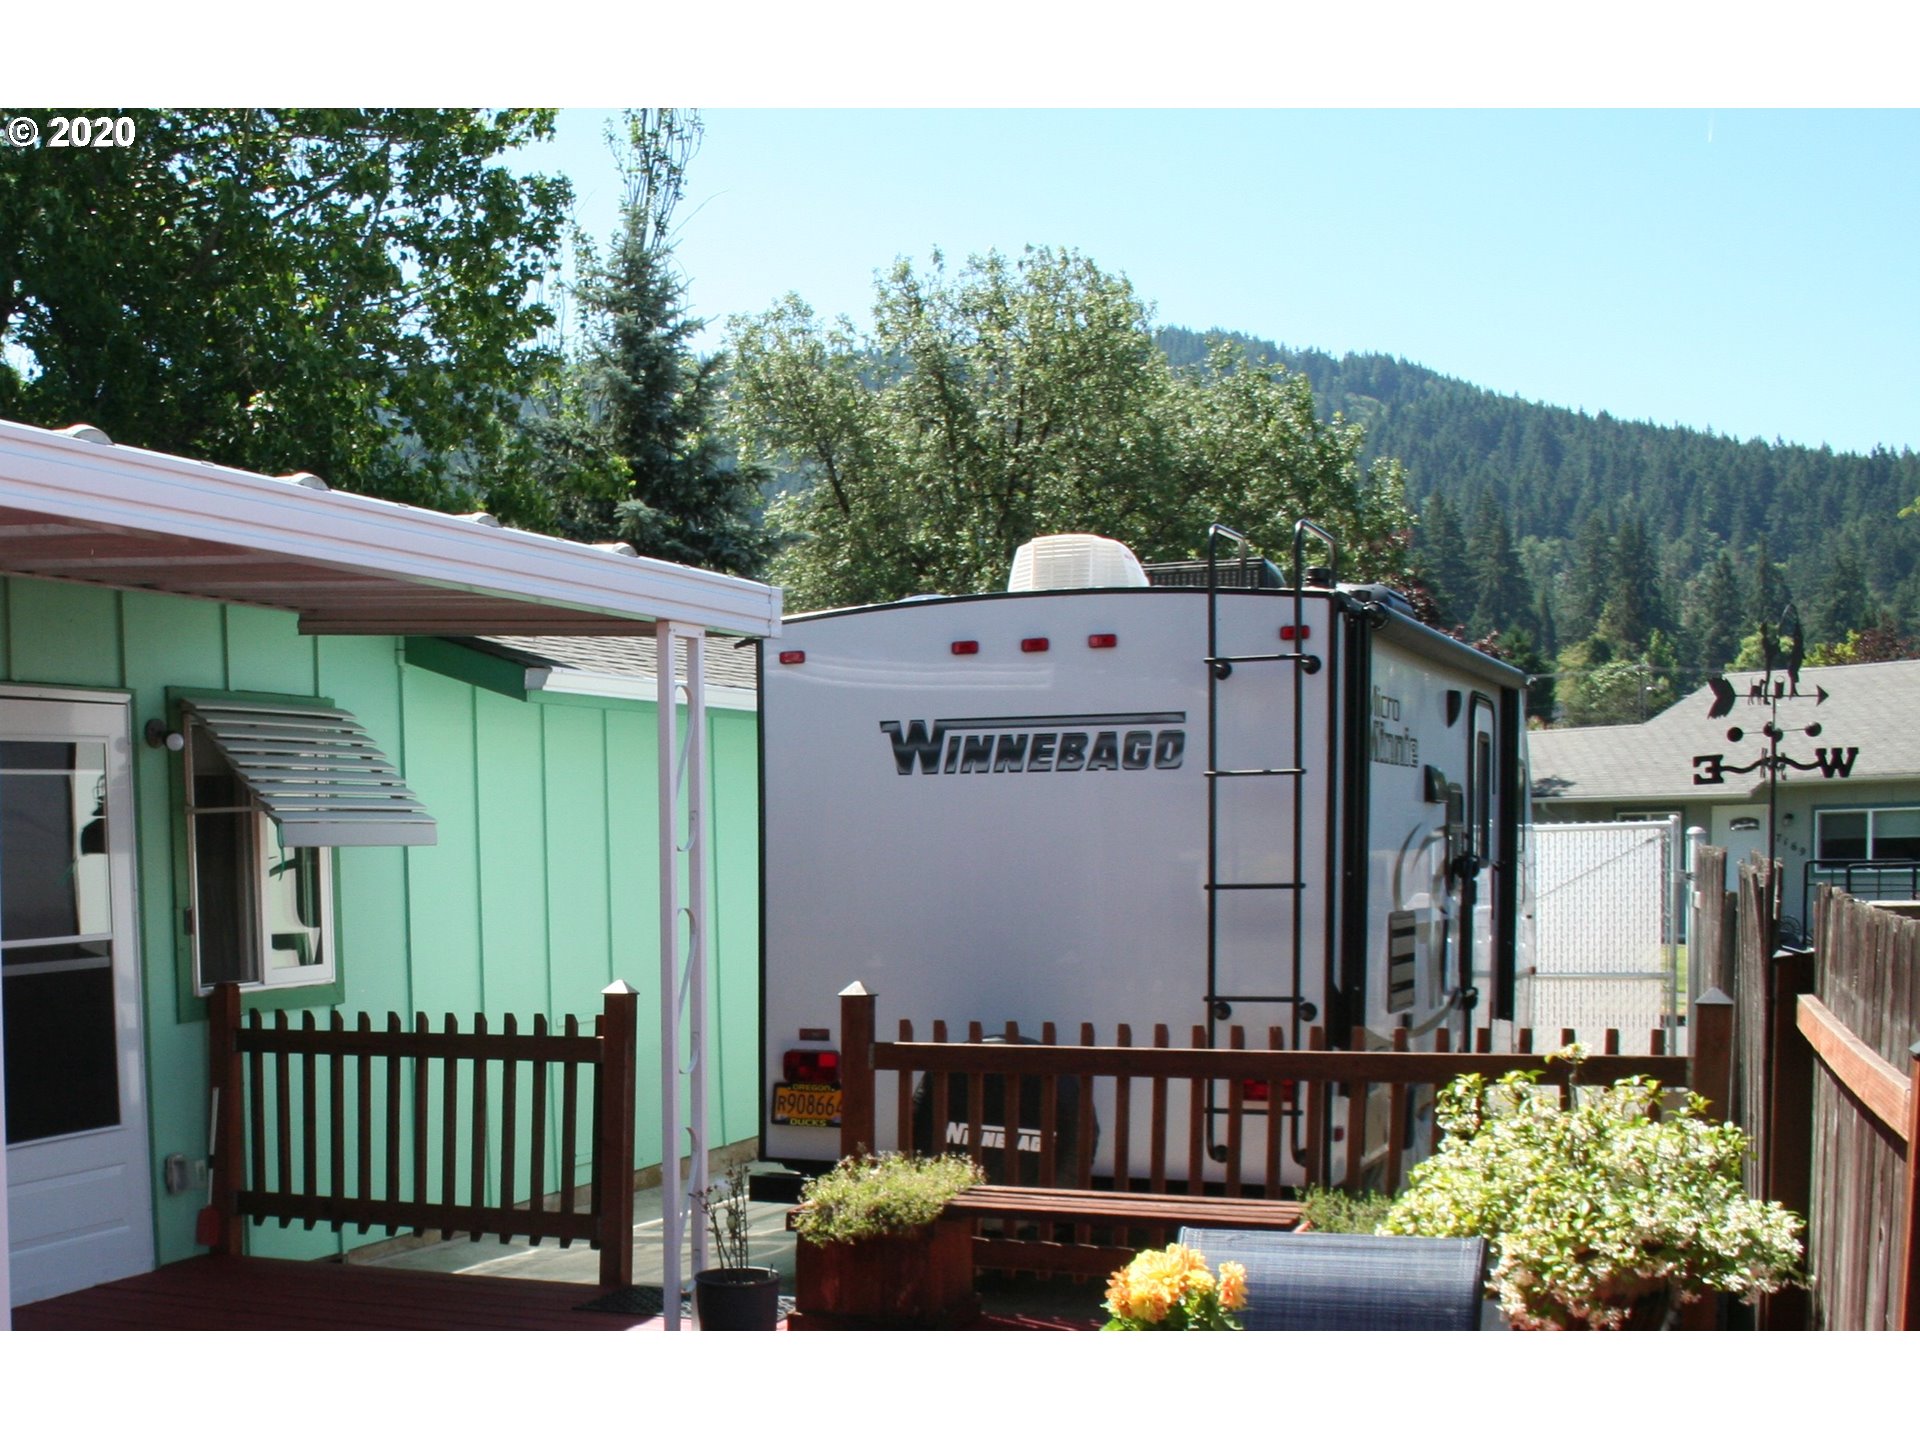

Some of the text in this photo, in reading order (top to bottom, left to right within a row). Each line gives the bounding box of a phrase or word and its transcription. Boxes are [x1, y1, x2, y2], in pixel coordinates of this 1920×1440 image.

[1371, 684, 1400, 721] icro
[879, 711, 1186, 775] WINNEBAGO
[790, 1118, 827, 1127] DUCKS
